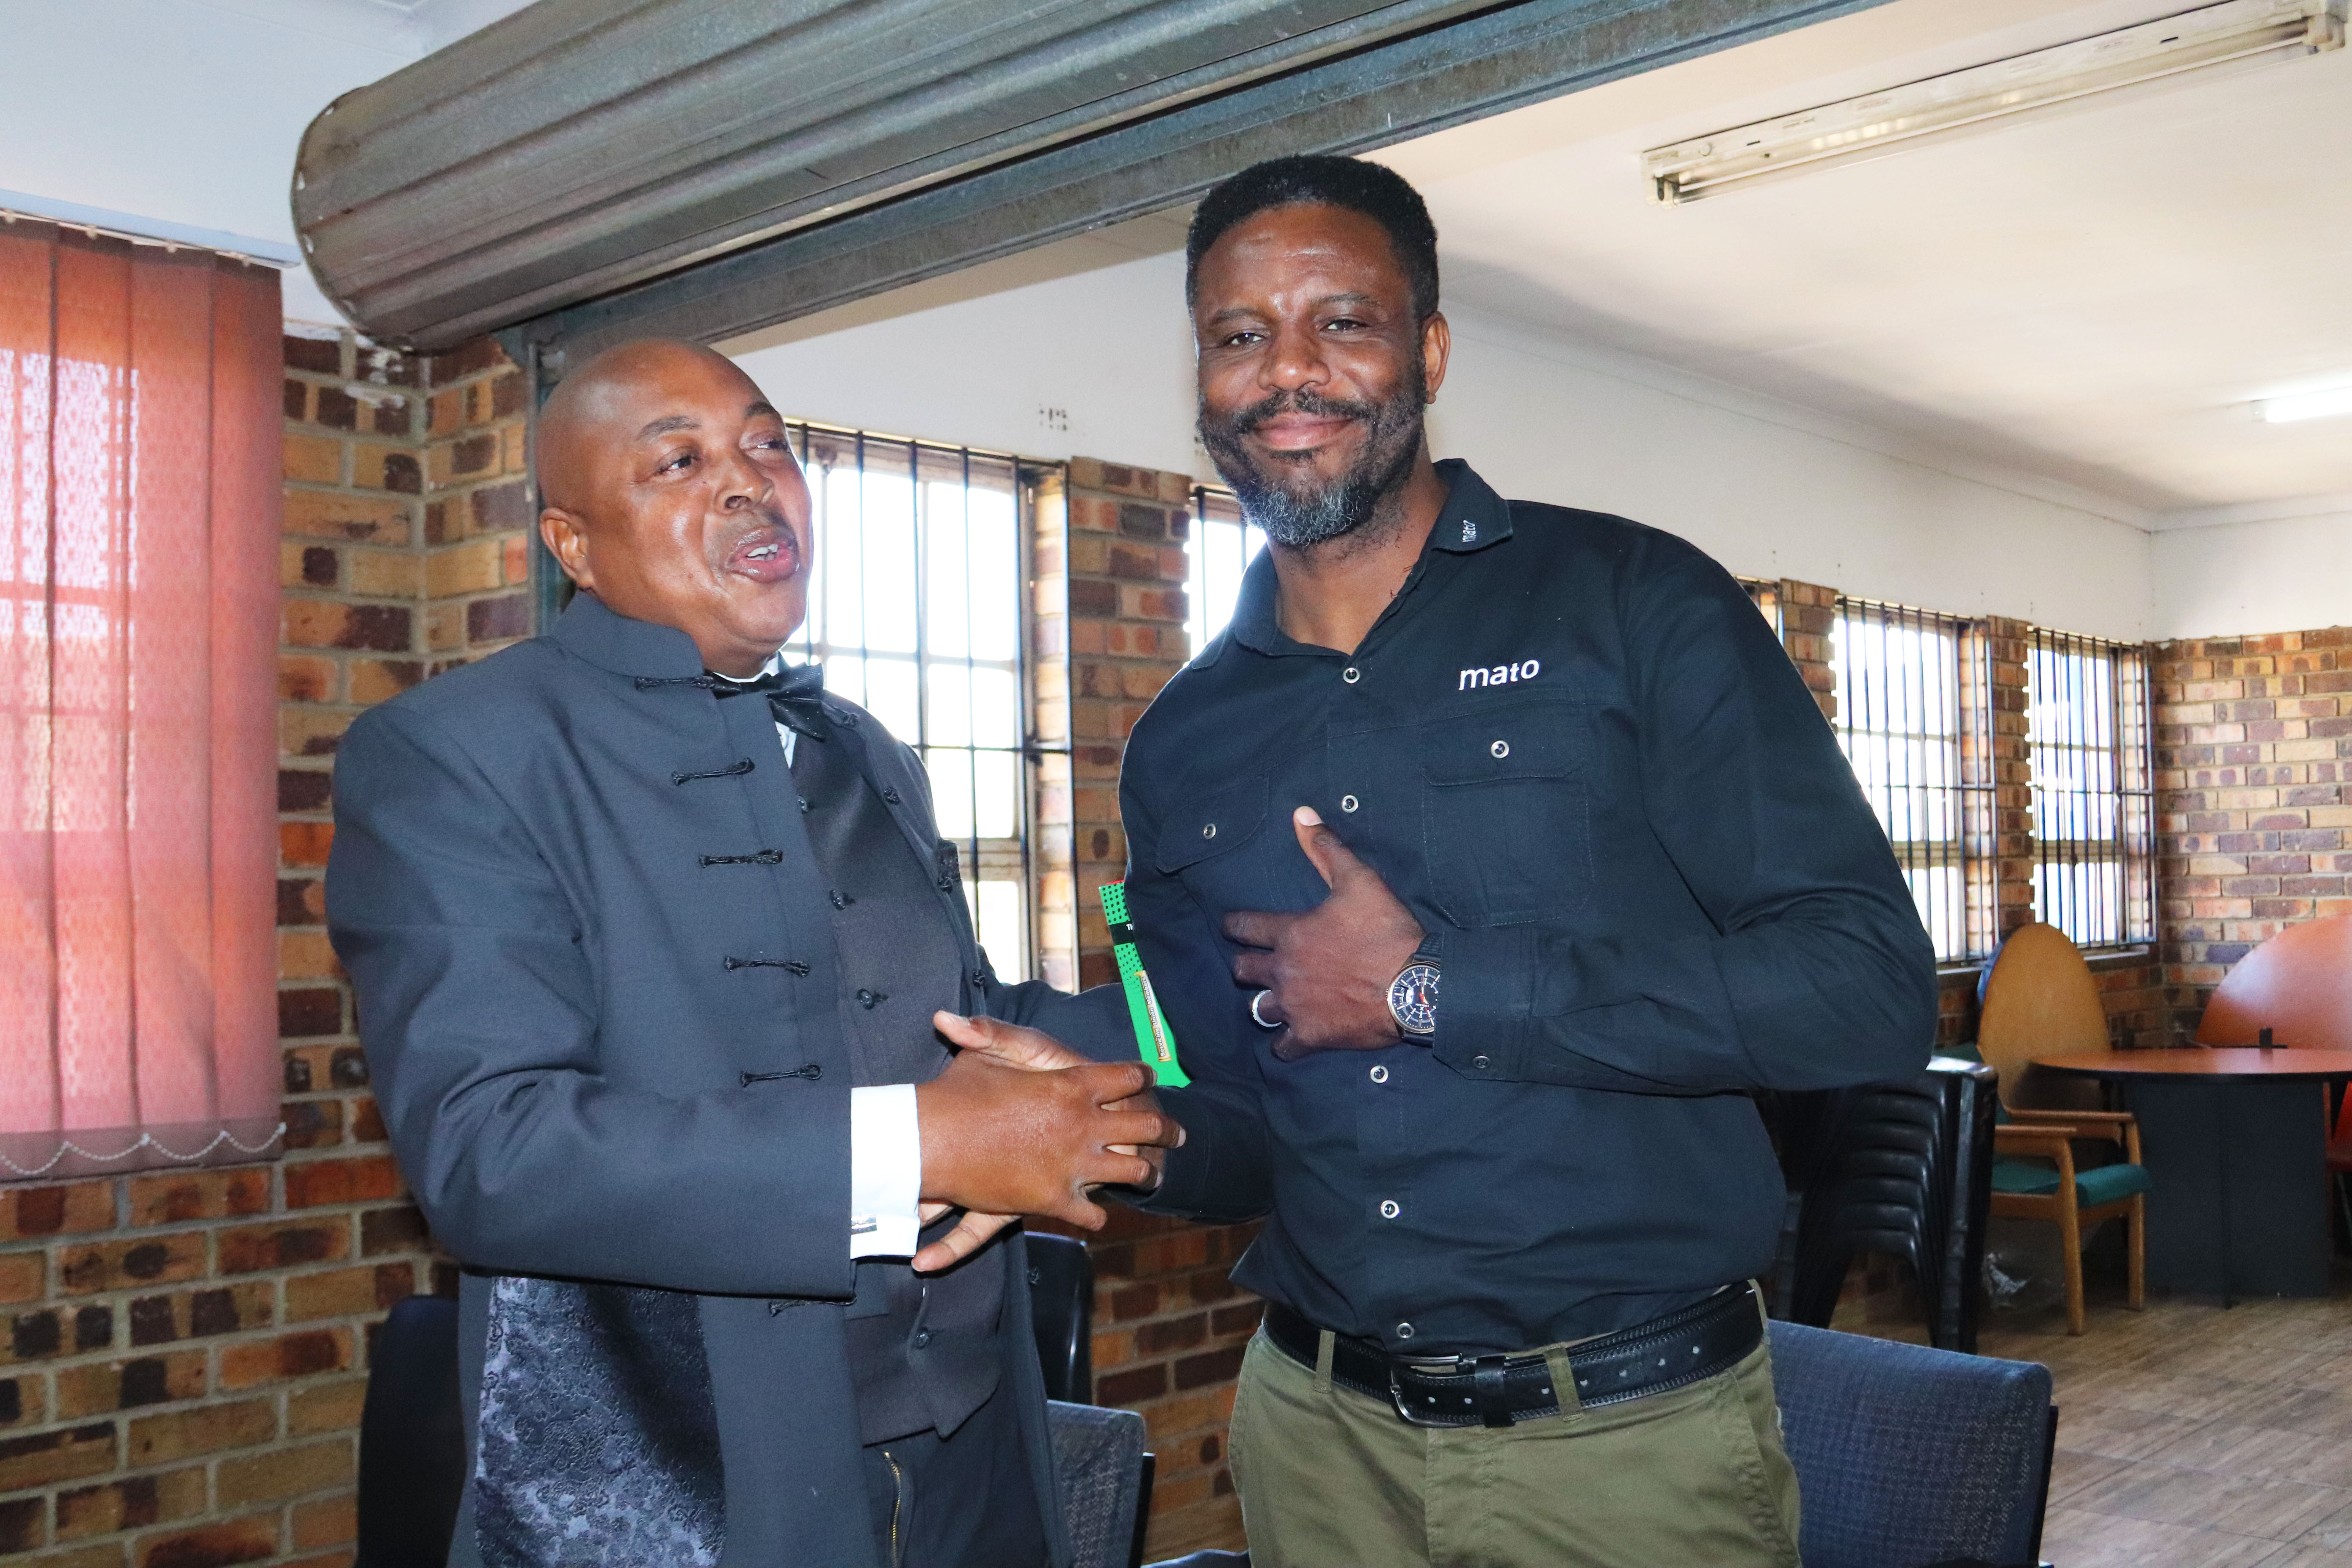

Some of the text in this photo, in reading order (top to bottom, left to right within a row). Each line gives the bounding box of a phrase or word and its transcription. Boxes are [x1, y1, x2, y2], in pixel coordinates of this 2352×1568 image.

[1462, 520, 1476, 542] mato
[1459, 660, 1539, 690] mato
[1142, 976, 1165, 1056] Servicing Union Members
